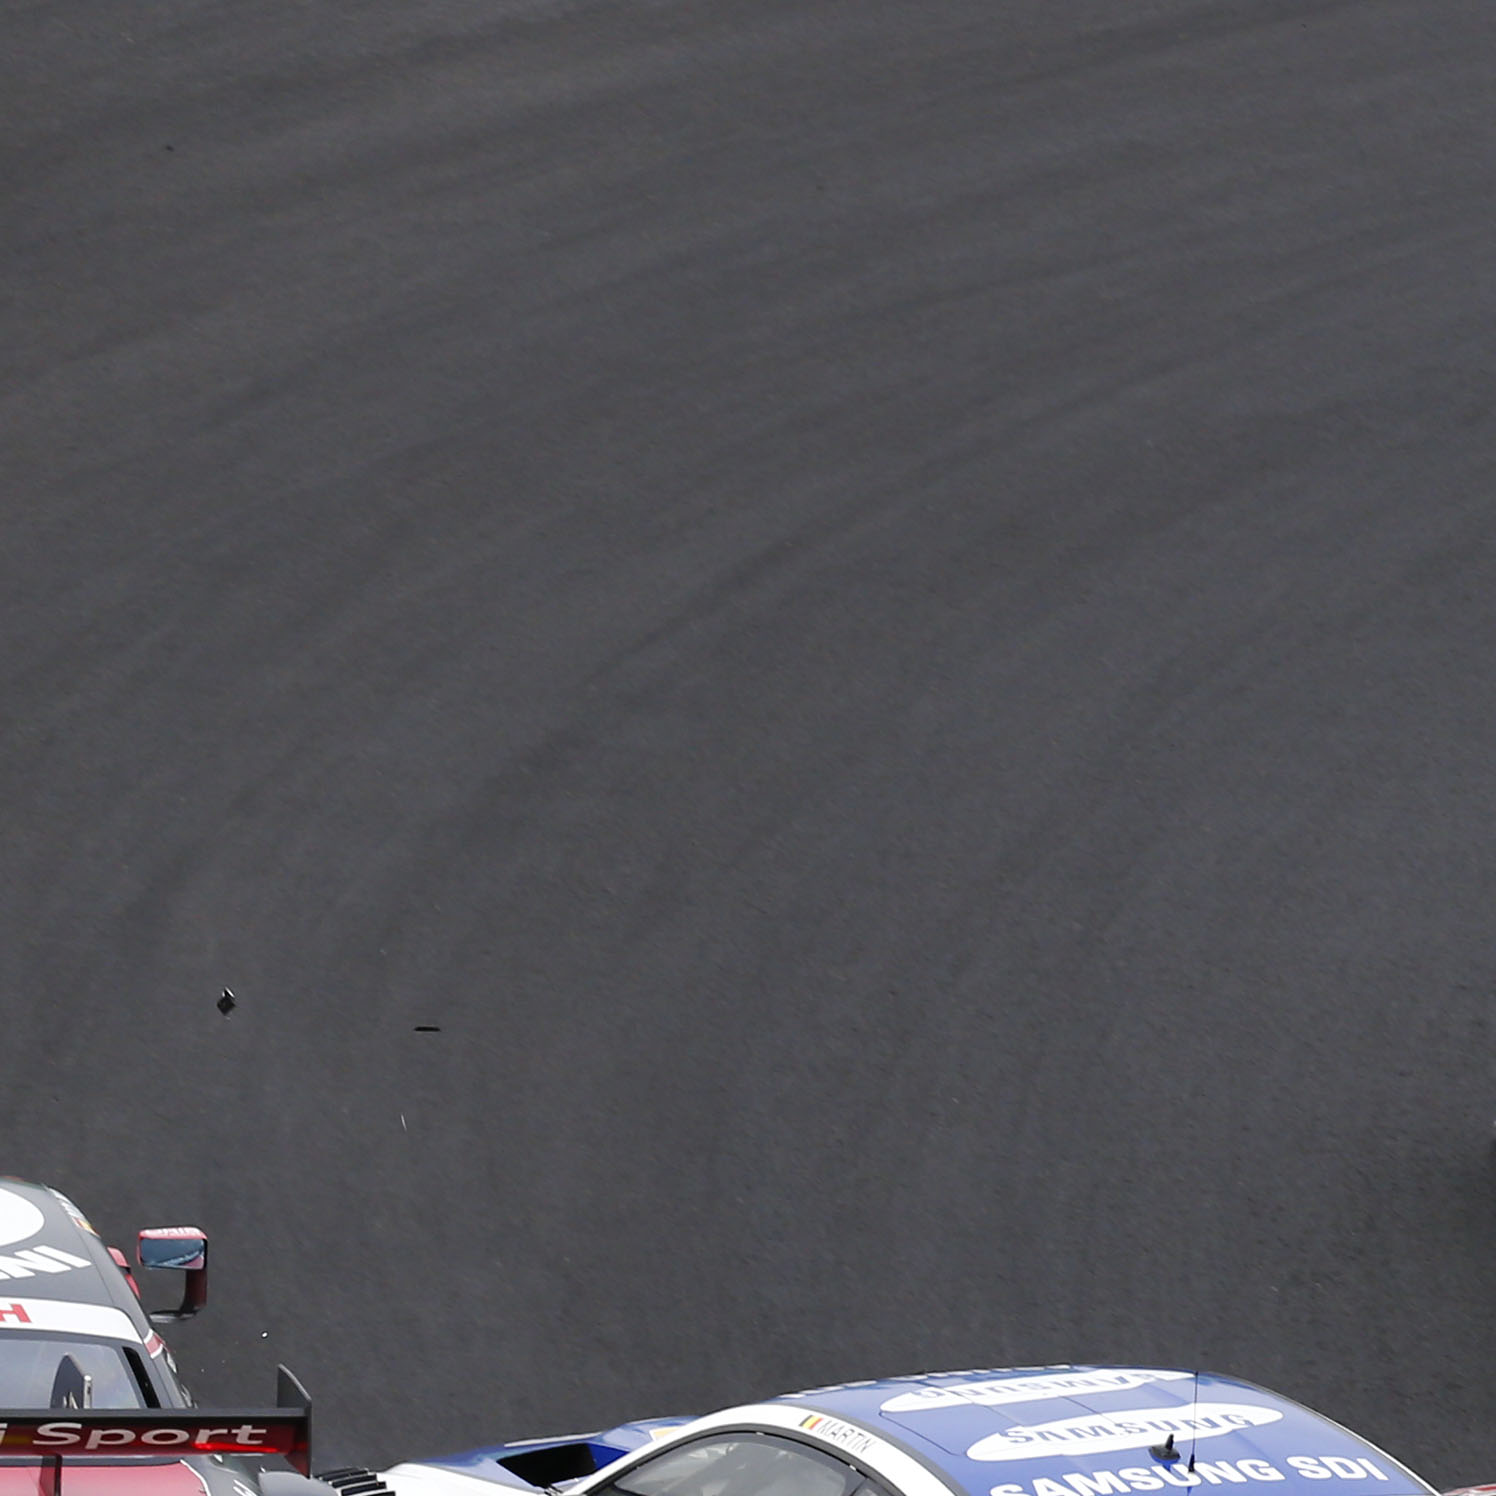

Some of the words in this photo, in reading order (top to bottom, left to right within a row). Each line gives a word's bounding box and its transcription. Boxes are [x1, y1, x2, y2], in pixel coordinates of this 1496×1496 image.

[33, 1422, 268, 1450] Sport
[816, 1419, 877, 1453] MARTIN
[1006, 1407, 1252, 1446] SAMSUNG
[1283, 1455, 1389, 1482] SDI
